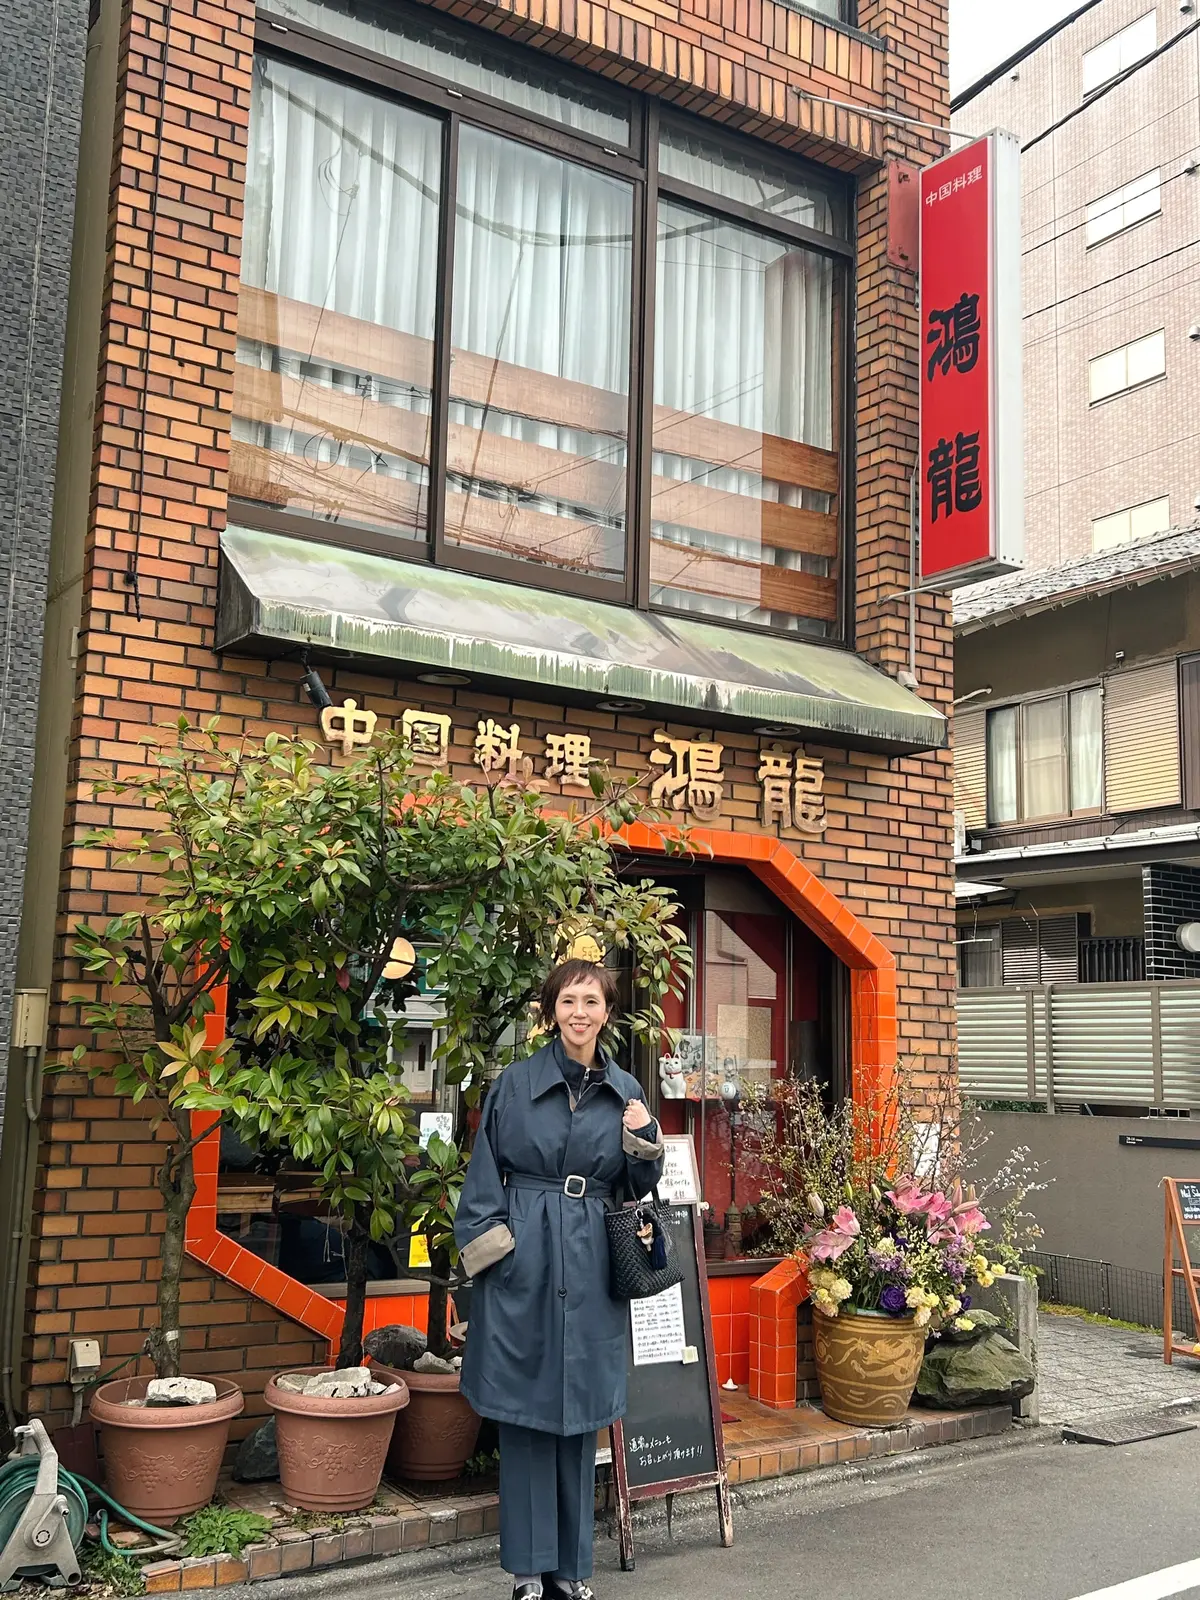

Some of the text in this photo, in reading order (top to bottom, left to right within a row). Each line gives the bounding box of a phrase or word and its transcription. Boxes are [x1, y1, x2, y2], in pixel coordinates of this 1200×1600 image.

[925, 164, 983, 208] 中国料理
[927, 292, 983, 524] 鴻龍
[320, 698, 828, 834] 中国料理 鴻龍
